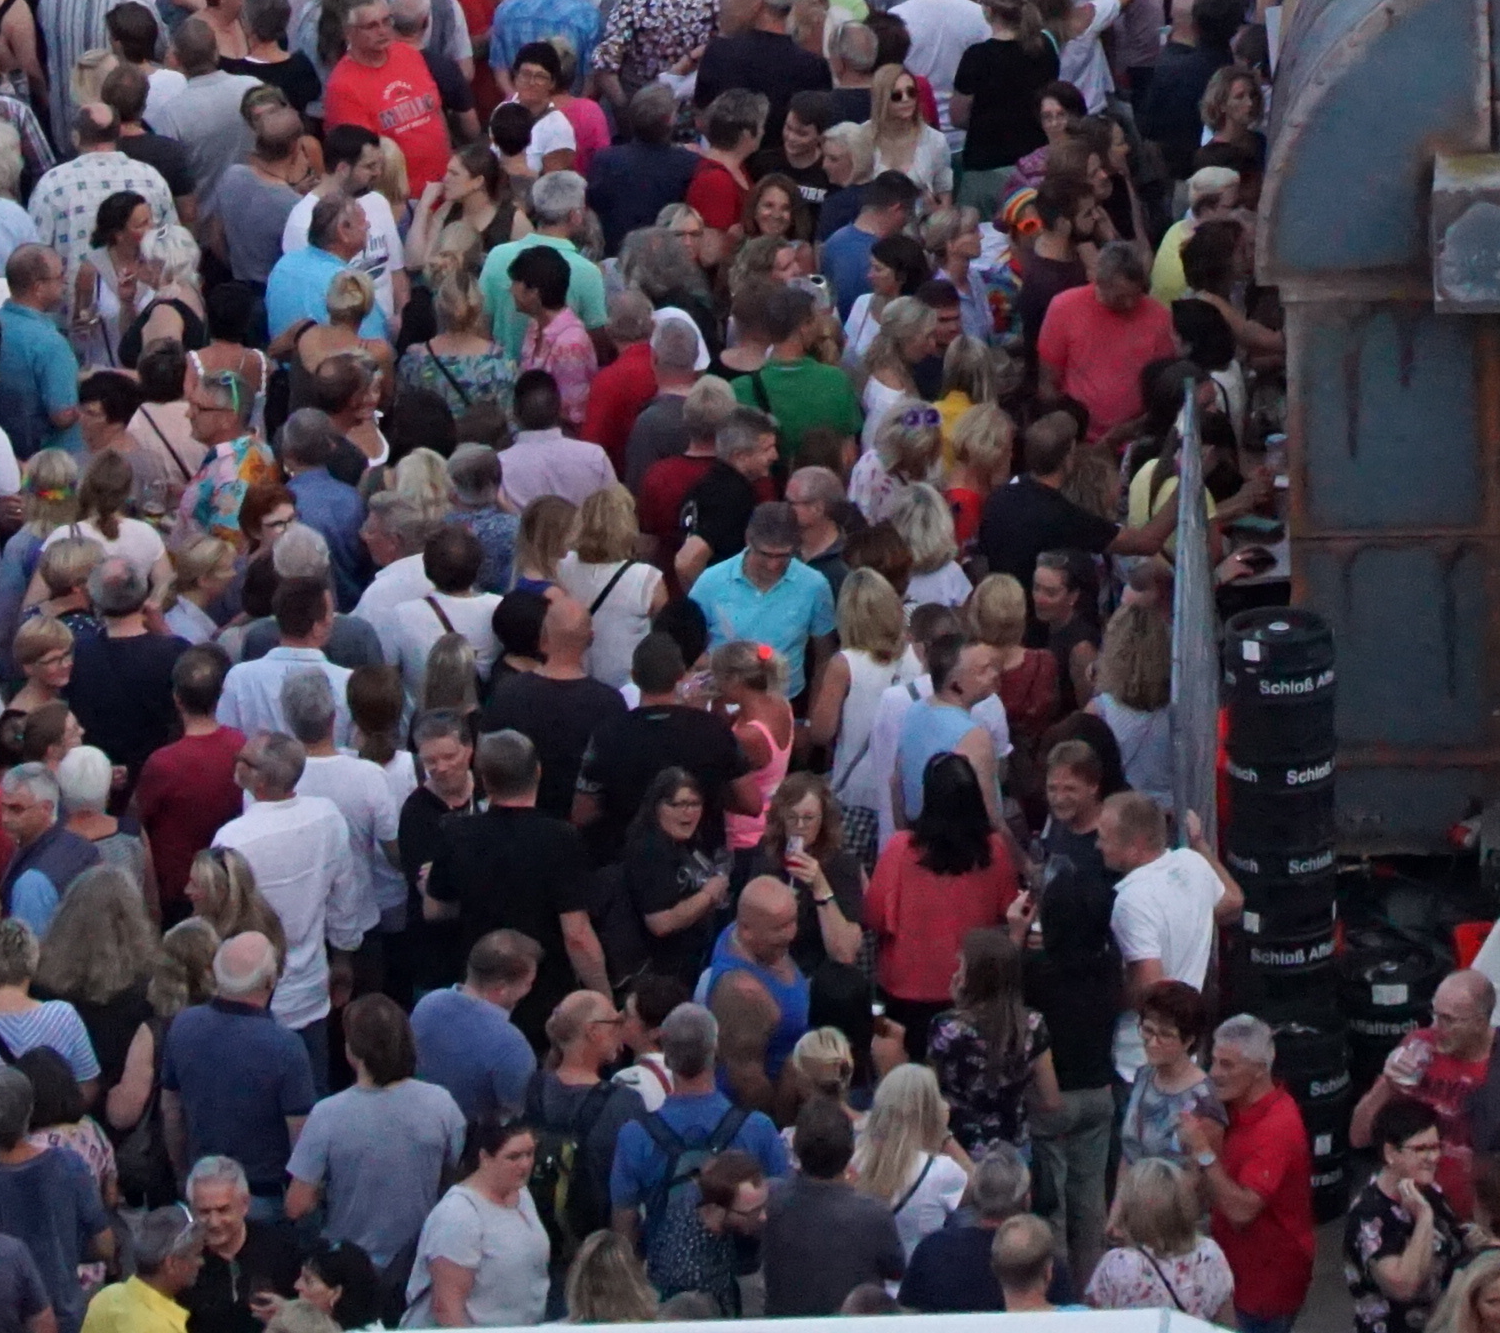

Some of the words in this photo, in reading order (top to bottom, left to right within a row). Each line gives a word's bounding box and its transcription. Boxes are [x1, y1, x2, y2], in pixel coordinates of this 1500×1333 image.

[1260, 678, 1313, 695] Schloß
[1286, 762, 1331, 785] Schloß
[1250, 948, 1304, 965] Schloß
